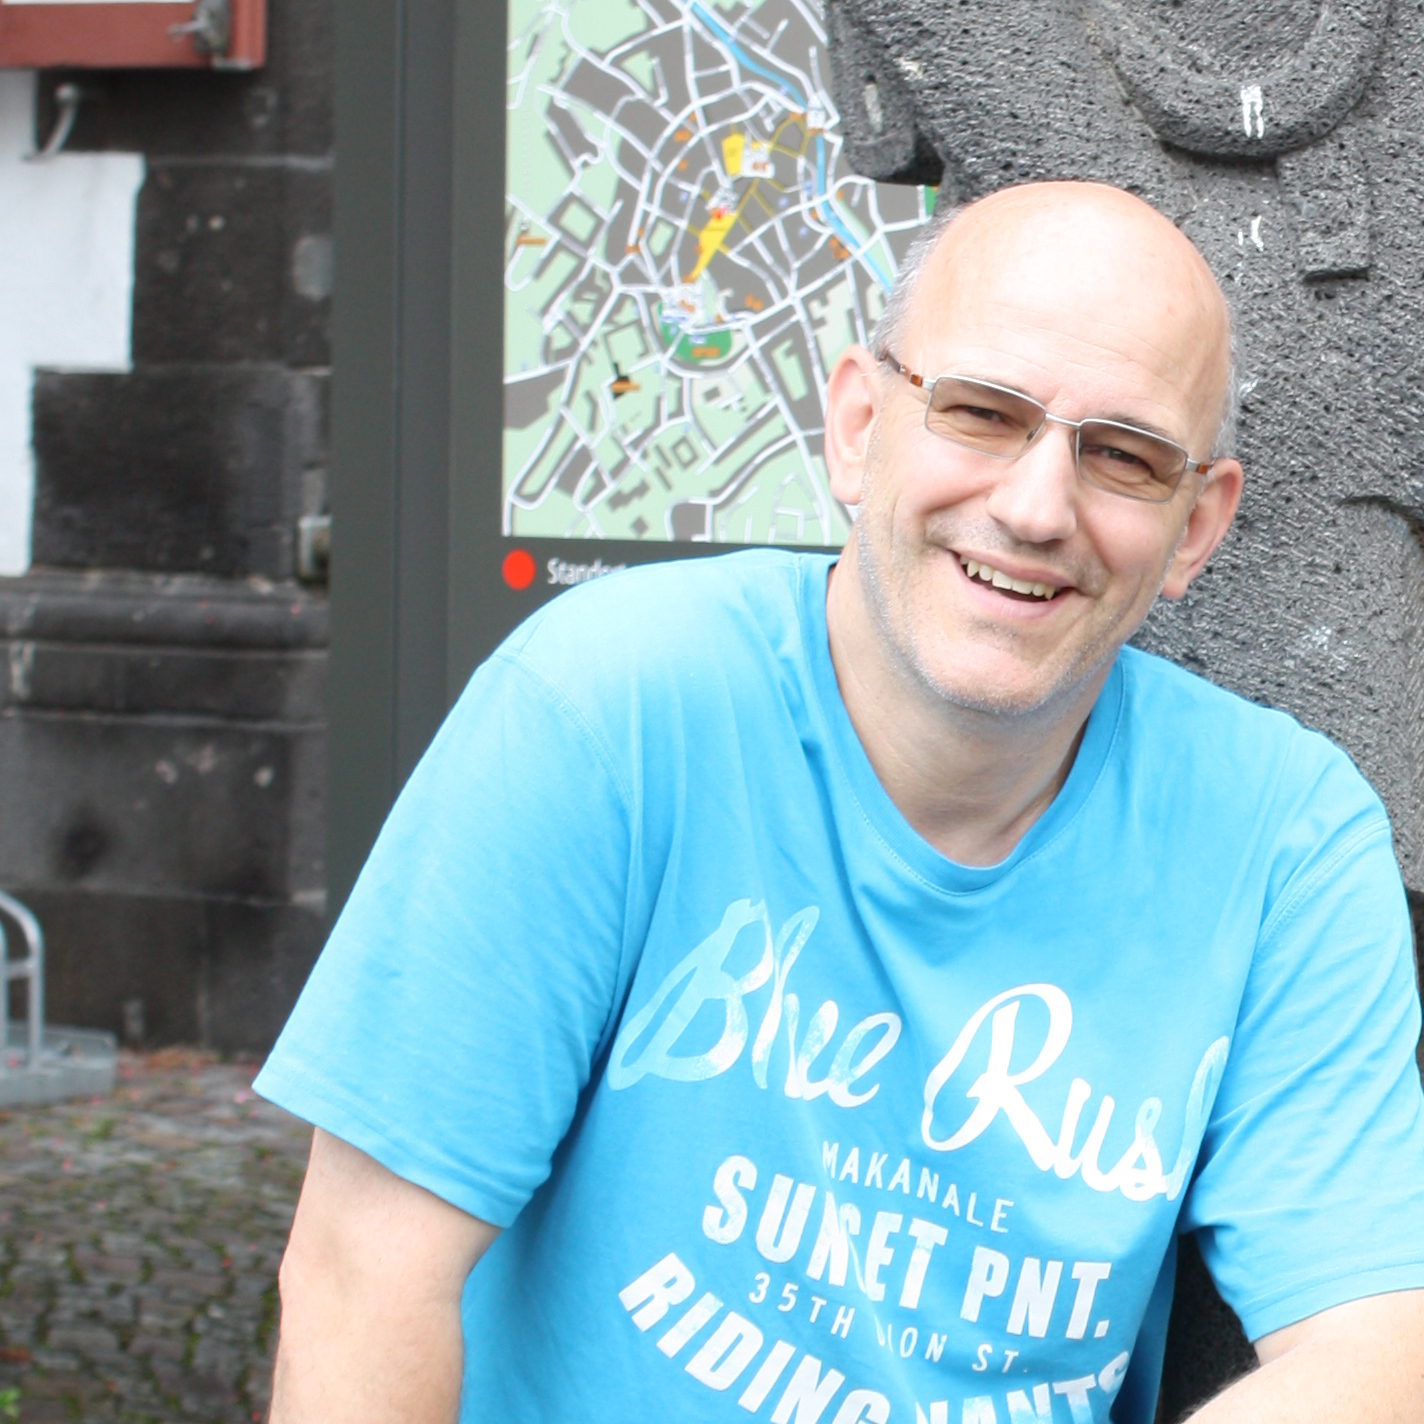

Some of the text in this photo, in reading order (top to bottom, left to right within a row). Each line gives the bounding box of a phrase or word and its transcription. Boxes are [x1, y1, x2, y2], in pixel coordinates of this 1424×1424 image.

[749, 1271, 856, 1339] 35TH
[972, 1342, 1028, 1374] ST.
[959, 1245, 1112, 1340] PNT.
